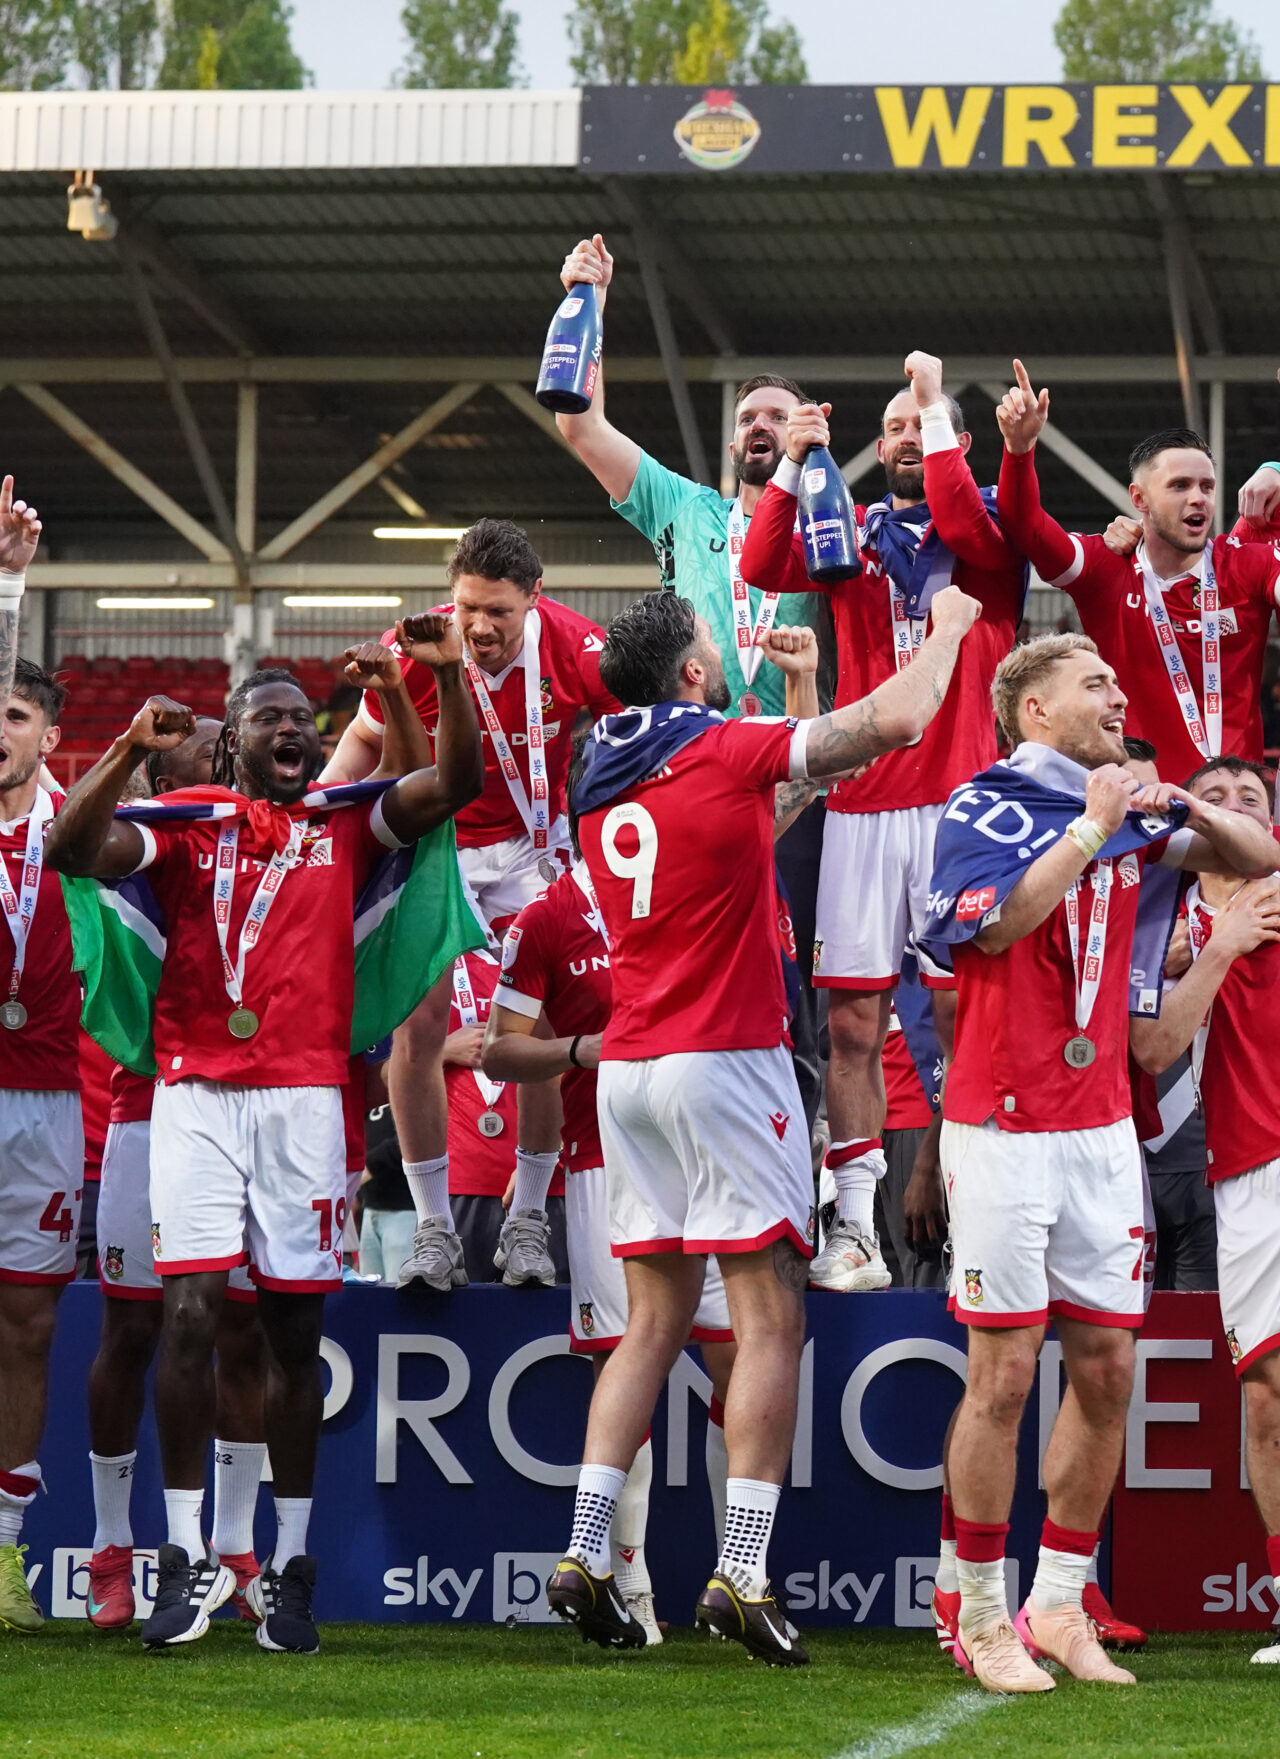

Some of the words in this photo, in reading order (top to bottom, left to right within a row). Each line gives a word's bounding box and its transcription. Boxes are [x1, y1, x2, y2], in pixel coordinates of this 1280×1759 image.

[591, 334, 603, 364] sky
[586, 366, 597, 394] bet
[732, 523, 741, 535] sky
[732, 537, 742, 555] bet
[819, 541, 831, 549] UP!
[1205, 571, 1215, 589] sky
[736, 581, 746, 600] bet
[895, 601, 906, 621] bet
[1206, 591, 1217, 611] bet
[738, 610, 748, 627] sky
[759, 608, 771, 626] sky
[1153, 605, 1165, 623] sky
[1159, 624, 1172, 645] bet
[739, 627, 750, 648] bet
[898, 631, 907, 649] sky
[913, 628, 923, 647] sky
[1205, 621, 1215, 640] sky
[1207, 641, 1217, 663] bet
[468, 663, 480, 682] bet
[1169, 654, 1181, 672] sky
[1176, 673, 1190, 694] bet
[1207, 672, 1218, 692] sky
[480, 692, 490, 710] sky
[486, 711, 499, 731] bet
[1185, 703, 1196, 720] sky
[1208, 694, 1219, 714] bet
[529, 706, 539, 726] sky
[530, 727, 541, 747] bet
[1190, 722, 1203, 743] bet
[497, 741, 508, 758] sky
[505, 760, 517, 779] bet
[532, 759, 543, 778] sky
[535, 779, 545, 798] bet
[535, 810, 547, 829] sky
[945, 783, 1058, 860] ED!
[223, 828, 234, 846] sky
[535, 831, 545, 847] bet
[29, 846, 39, 865] sky
[221, 848, 233, 867] bet
[601, 802, 658, 920] 9
[26, 866, 38, 887] bet
[265, 871, 282, 892] bet
[217, 880, 231, 899] sky
[1097, 877, 1108, 899] sky
[5, 893, 15, 914] bet
[22, 897, 33, 915] sky
[218, 901, 229, 923] bet
[252, 901, 266, 920] sky
[1068, 902, 1077, 925] bet
[1094, 900, 1106, 923] bet
[244, 922, 260, 943] bet
[1089, 935, 1100, 957] sky
[1086, 958, 1099, 981] bet
[457, 976, 467, 992] sky
[461, 992, 472, 1007] bet
[383, 1555, 484, 1618] sky
[785, 1560, 885, 1623] sky
